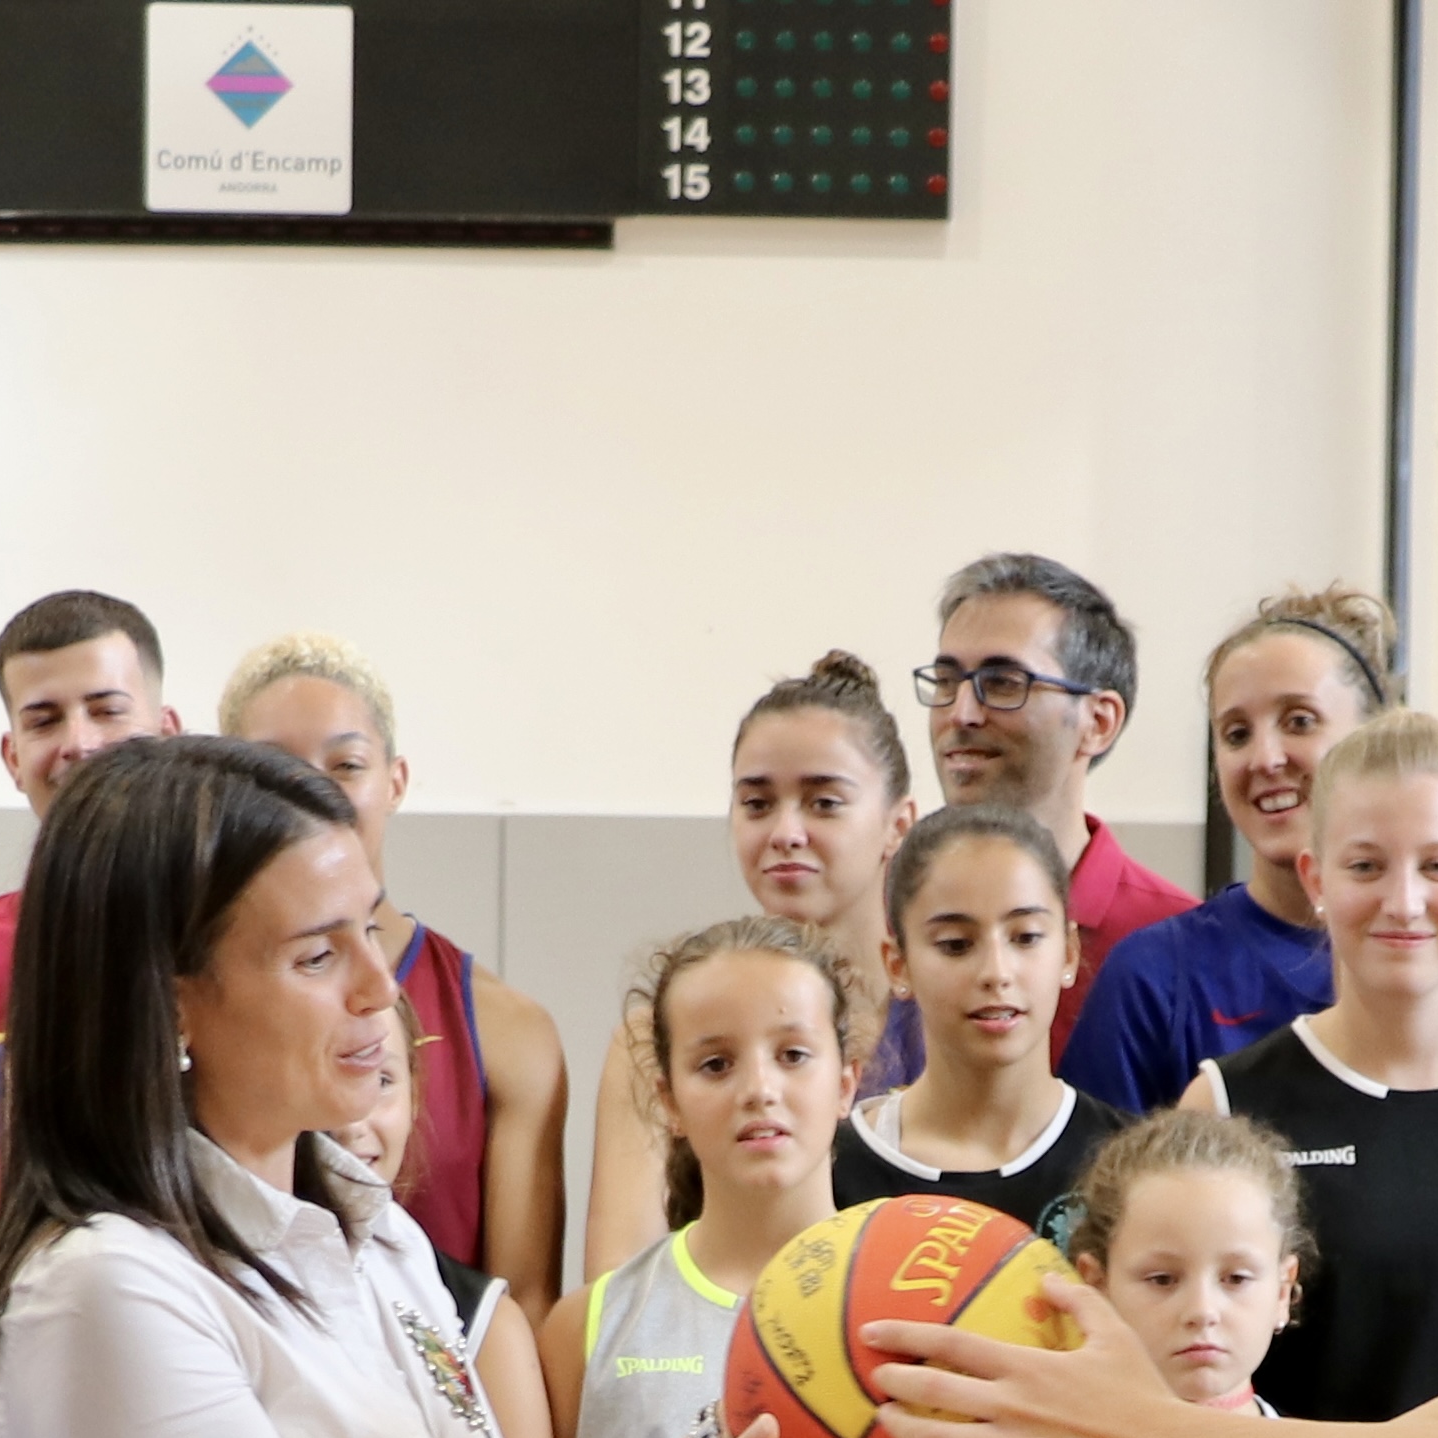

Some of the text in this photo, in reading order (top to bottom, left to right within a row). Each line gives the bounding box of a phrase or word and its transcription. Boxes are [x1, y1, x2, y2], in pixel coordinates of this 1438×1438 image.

[663, 21, 711, 58] 12
[663, 68, 711, 105] 13
[663, 116, 711, 152] 14
[156, 148, 223, 171] Comú
[218, 181, 278, 194] ANDORRA
[663, 163, 711, 200] 15
[616, 1355, 704, 1378] SPALDING
